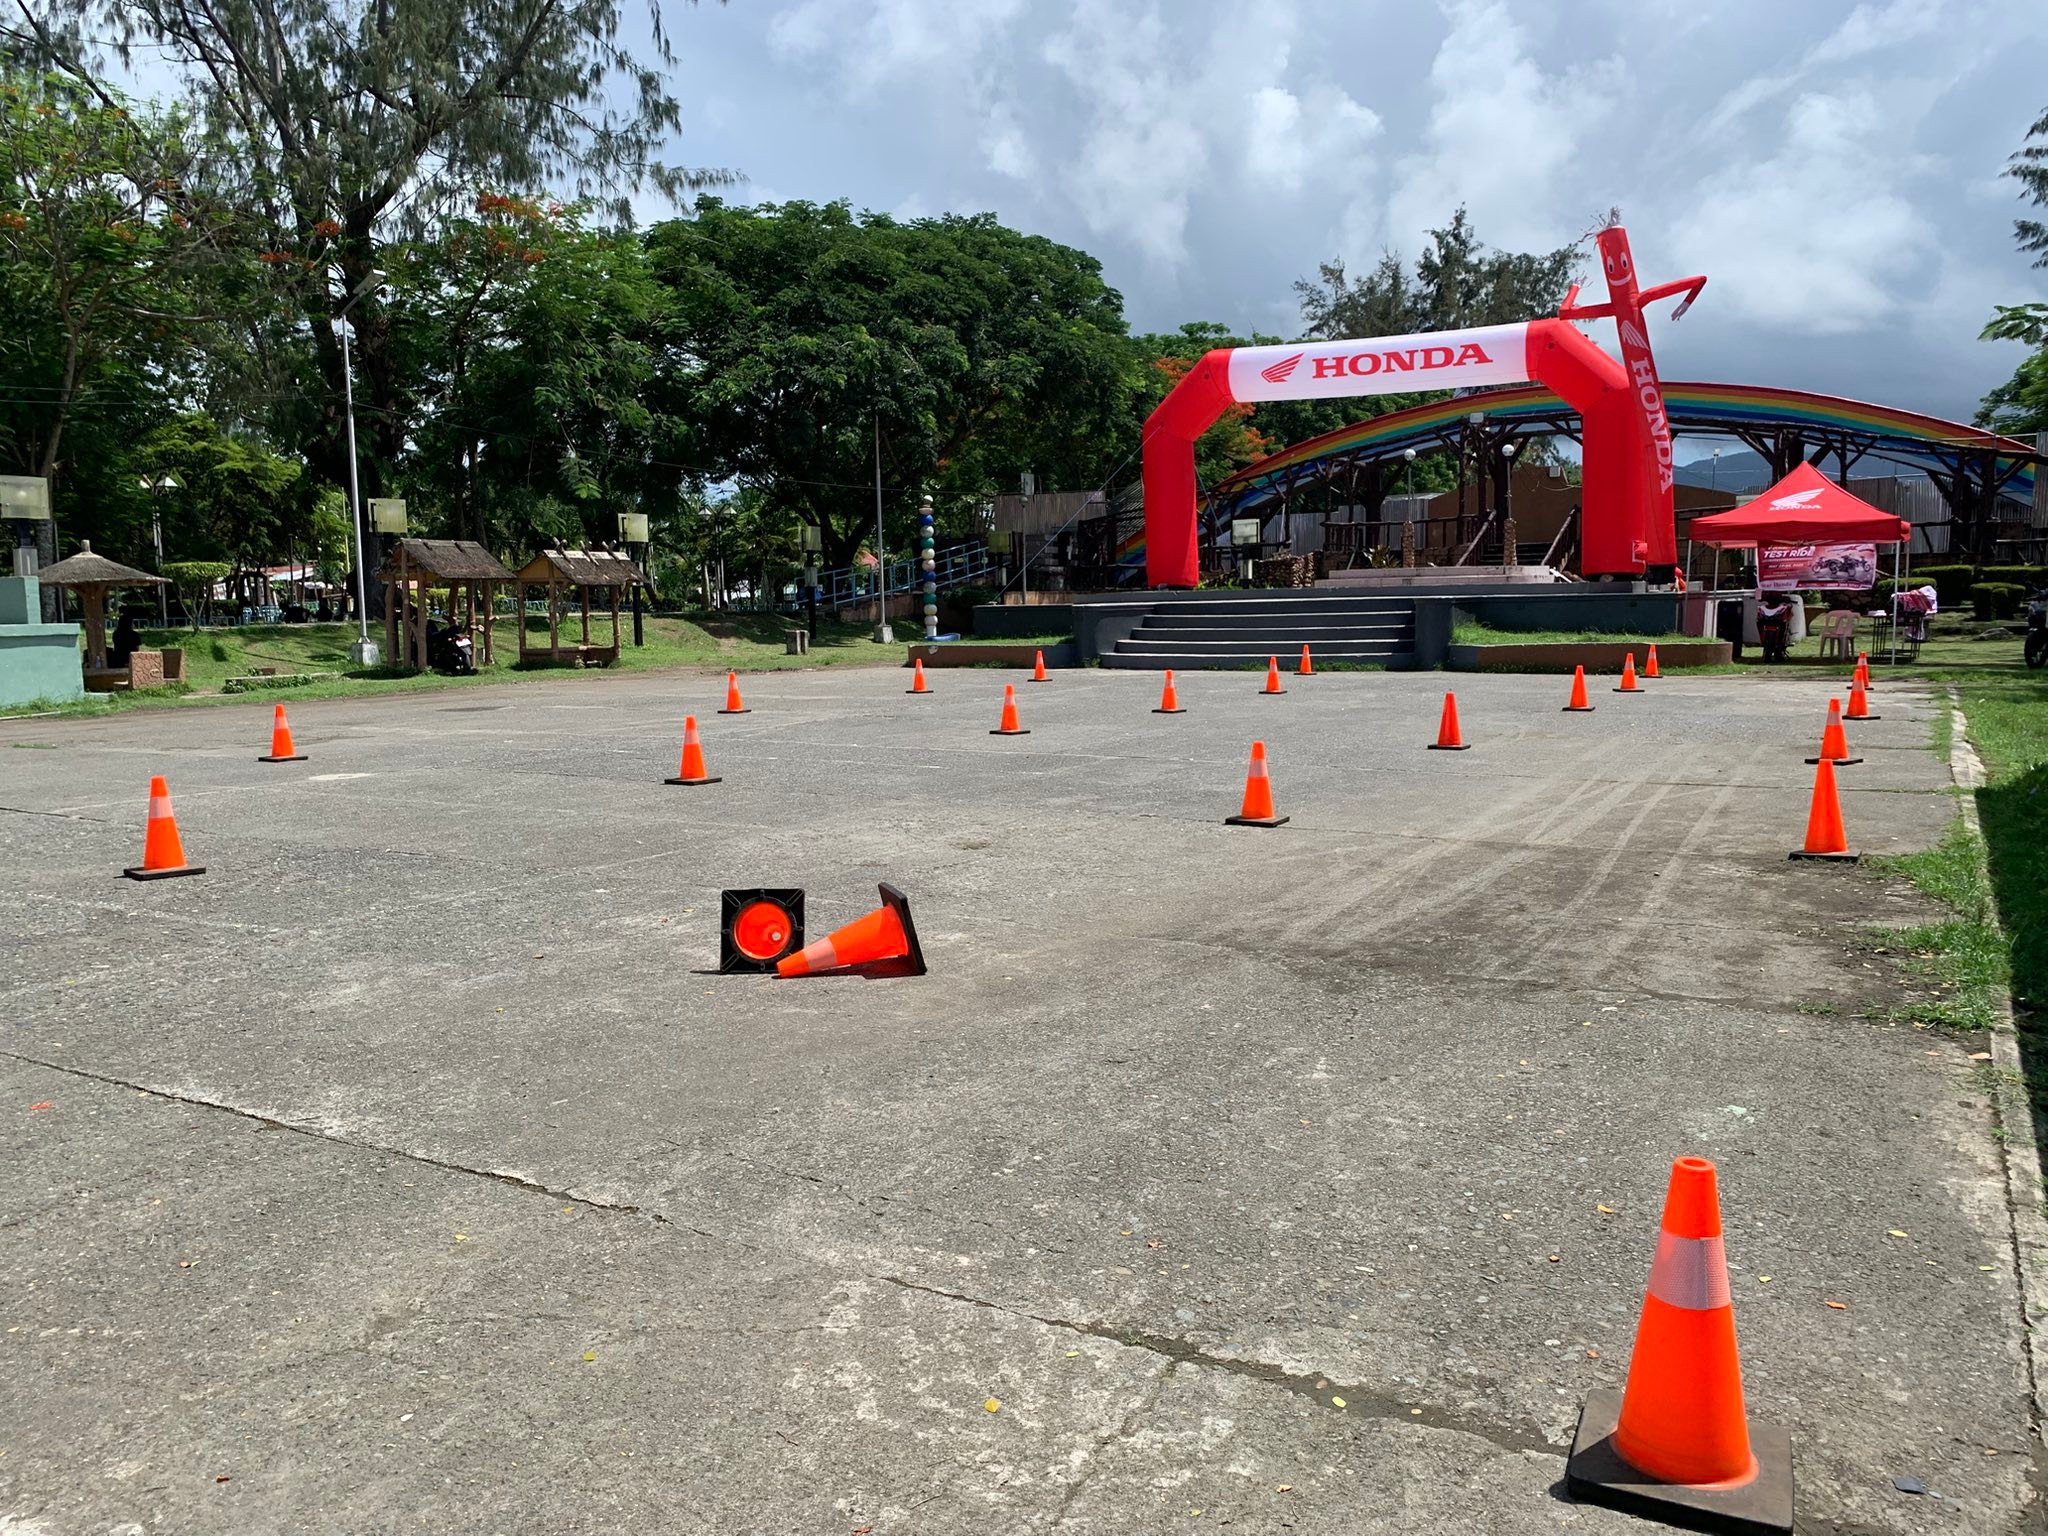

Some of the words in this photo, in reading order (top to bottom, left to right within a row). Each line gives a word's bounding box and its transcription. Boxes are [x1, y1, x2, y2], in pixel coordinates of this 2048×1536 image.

[1312, 343, 1493, 379] HONDA
[1631, 357, 1673, 494] HONDA
[1764, 550, 1789, 558] TEST
[1789, 547, 1816, 556] RIDE
